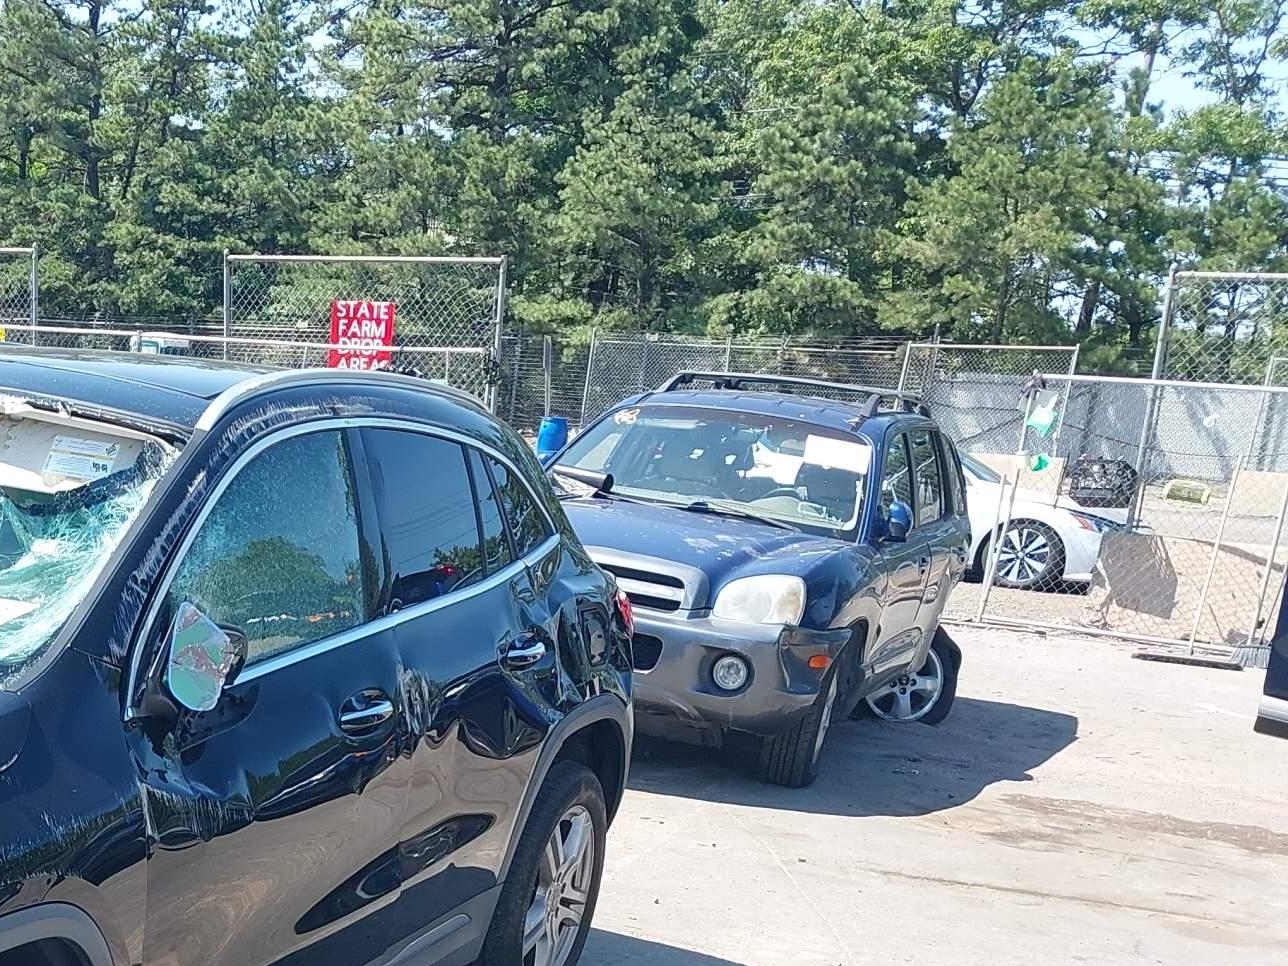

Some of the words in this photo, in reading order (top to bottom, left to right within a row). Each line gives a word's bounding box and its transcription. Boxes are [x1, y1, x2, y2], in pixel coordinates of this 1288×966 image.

[336, 300, 390, 319] STATE
[338, 318, 387, 338] FARM
[338, 337, 384, 356] DROP
